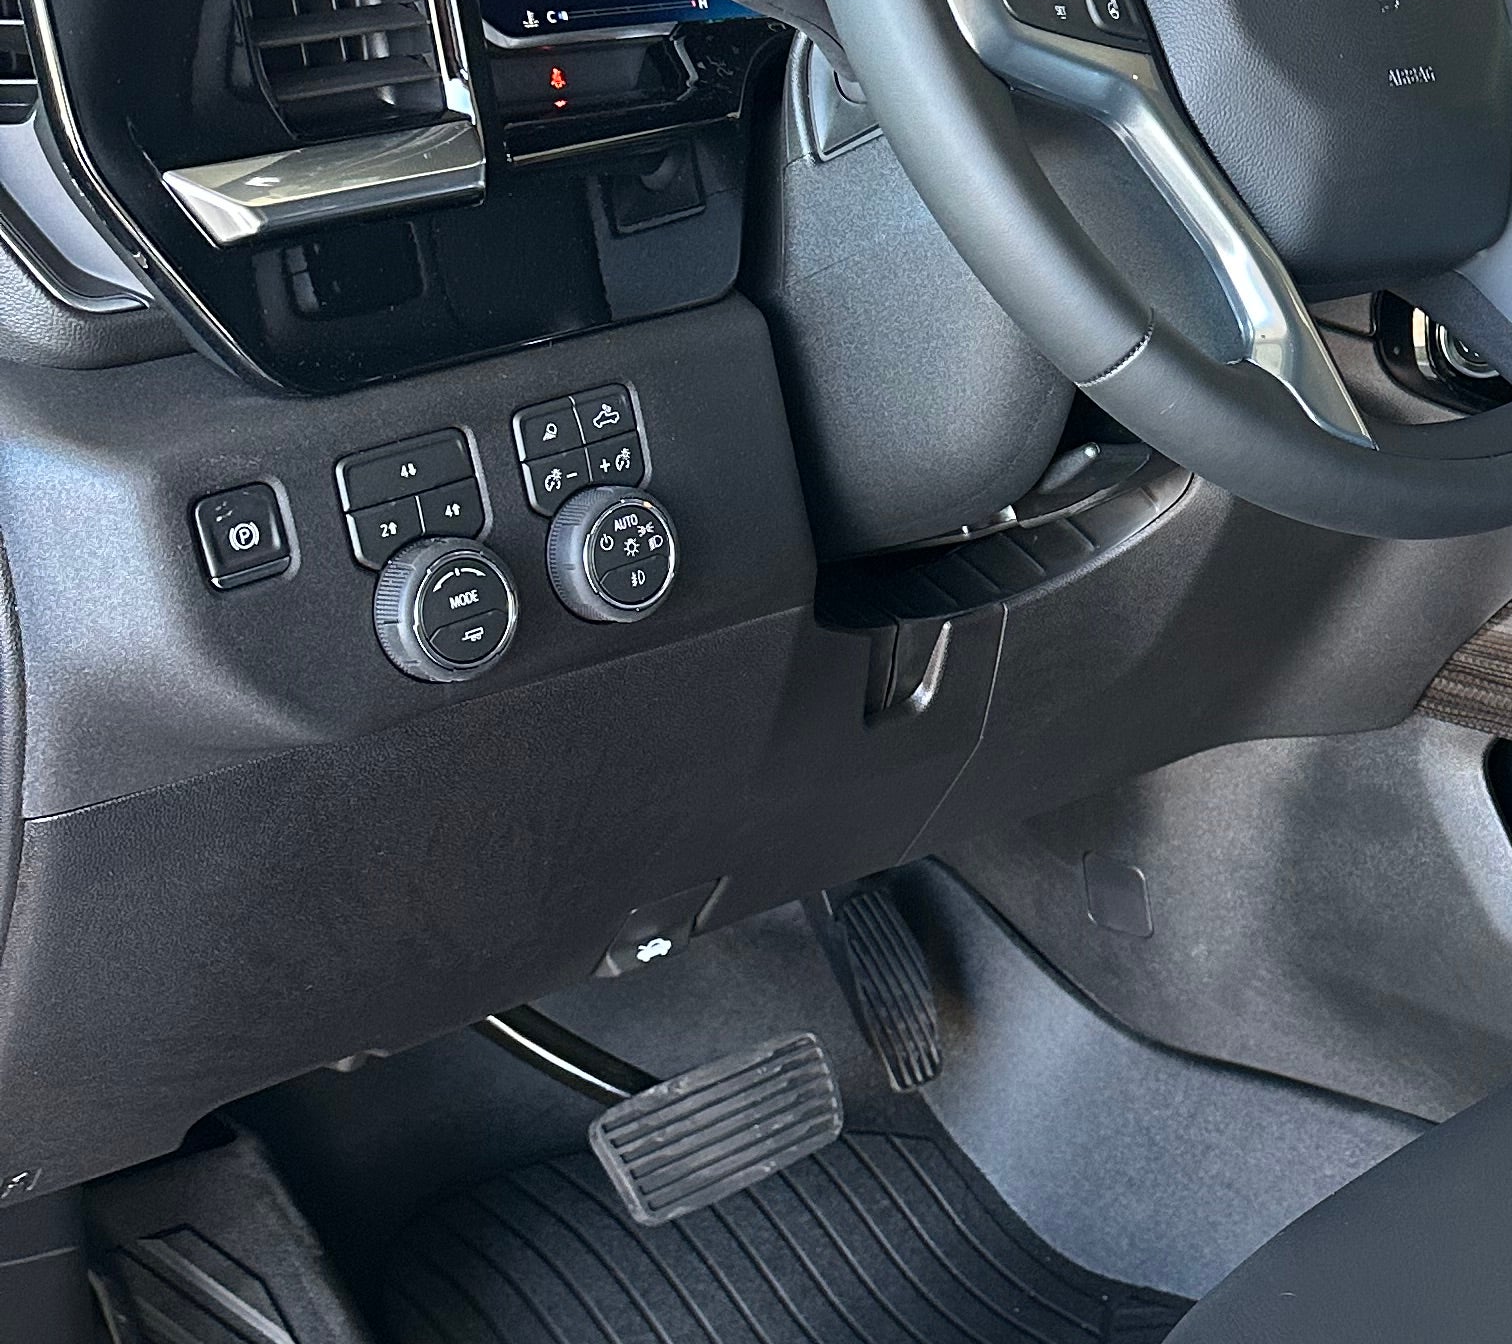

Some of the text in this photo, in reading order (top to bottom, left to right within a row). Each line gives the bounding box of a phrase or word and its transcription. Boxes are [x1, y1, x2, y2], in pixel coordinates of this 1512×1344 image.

[546, 9, 557, 24] C
[1389, 66, 1436, 87] AIRBAG
[614, 513, 639, 532] AUTO
[449, 589, 480, 610] MODE
